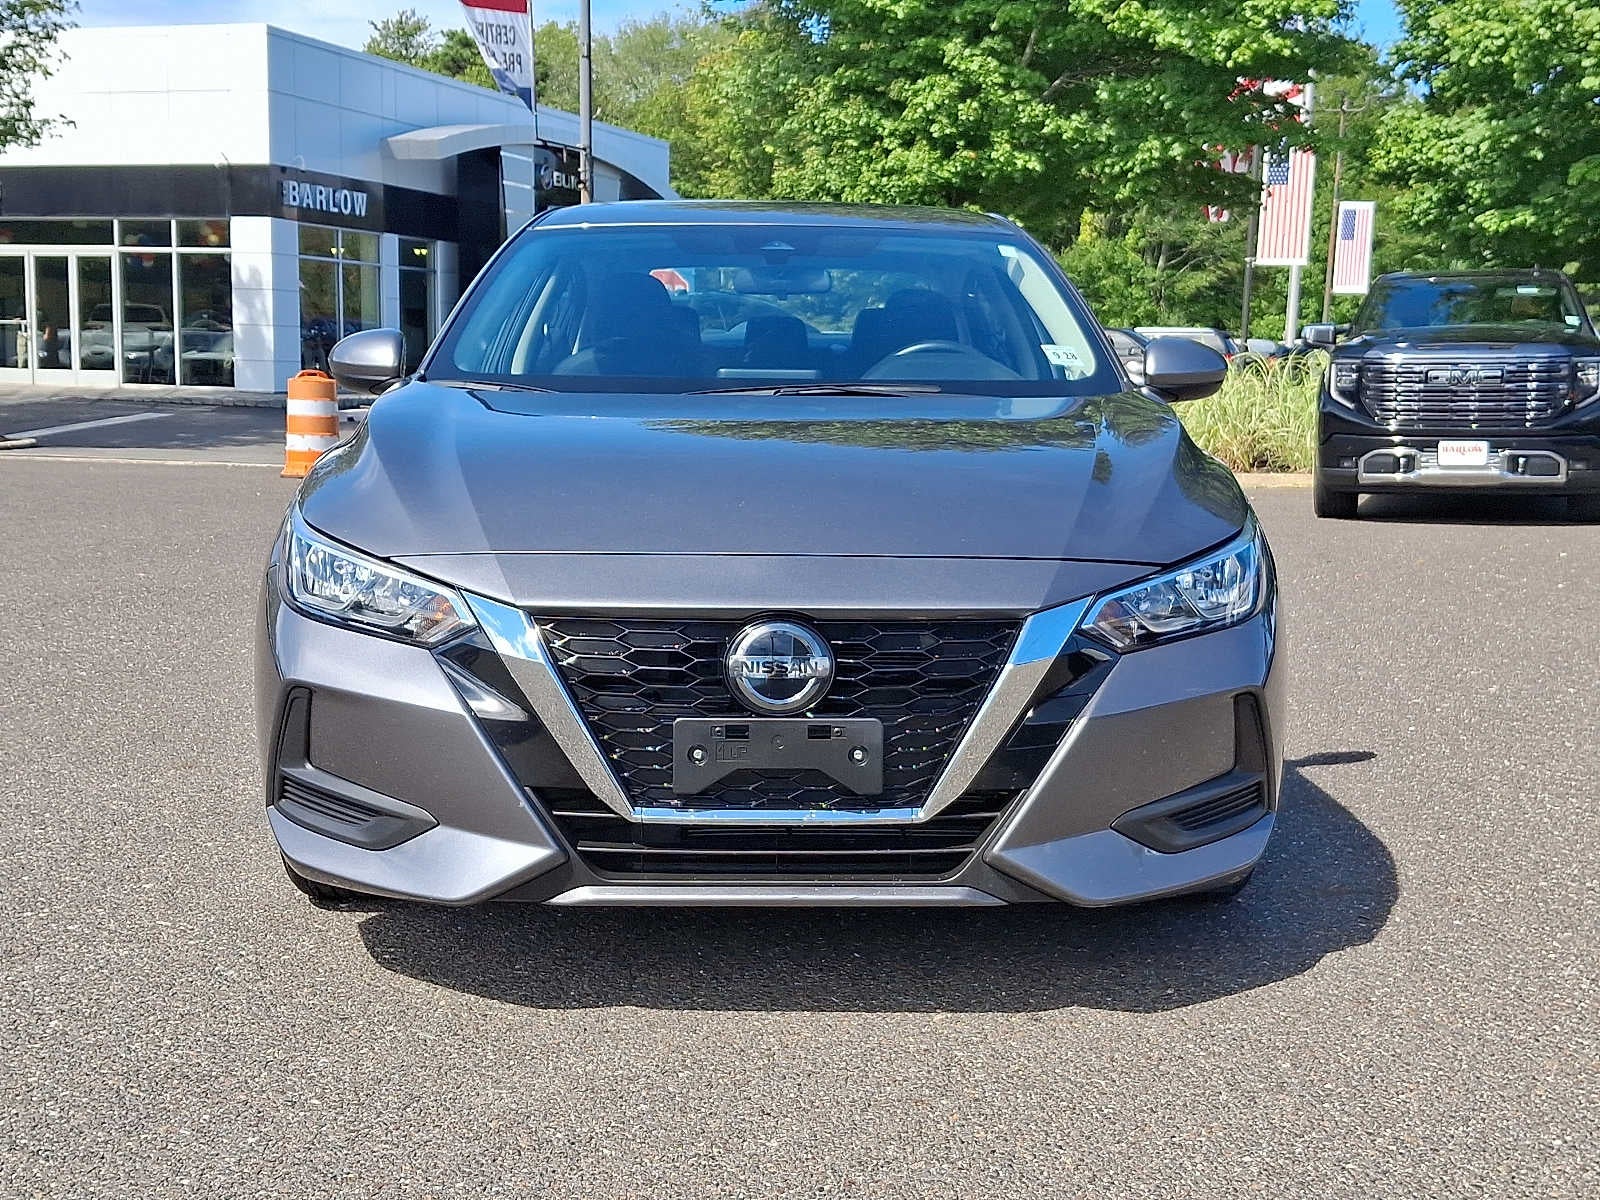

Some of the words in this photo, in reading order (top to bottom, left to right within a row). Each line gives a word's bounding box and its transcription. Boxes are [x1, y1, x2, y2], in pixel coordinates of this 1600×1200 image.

[284, 180, 368, 217] BARLOW
[1427, 369, 1503, 385] GMC
[741, 660, 818, 675] NISSAN
